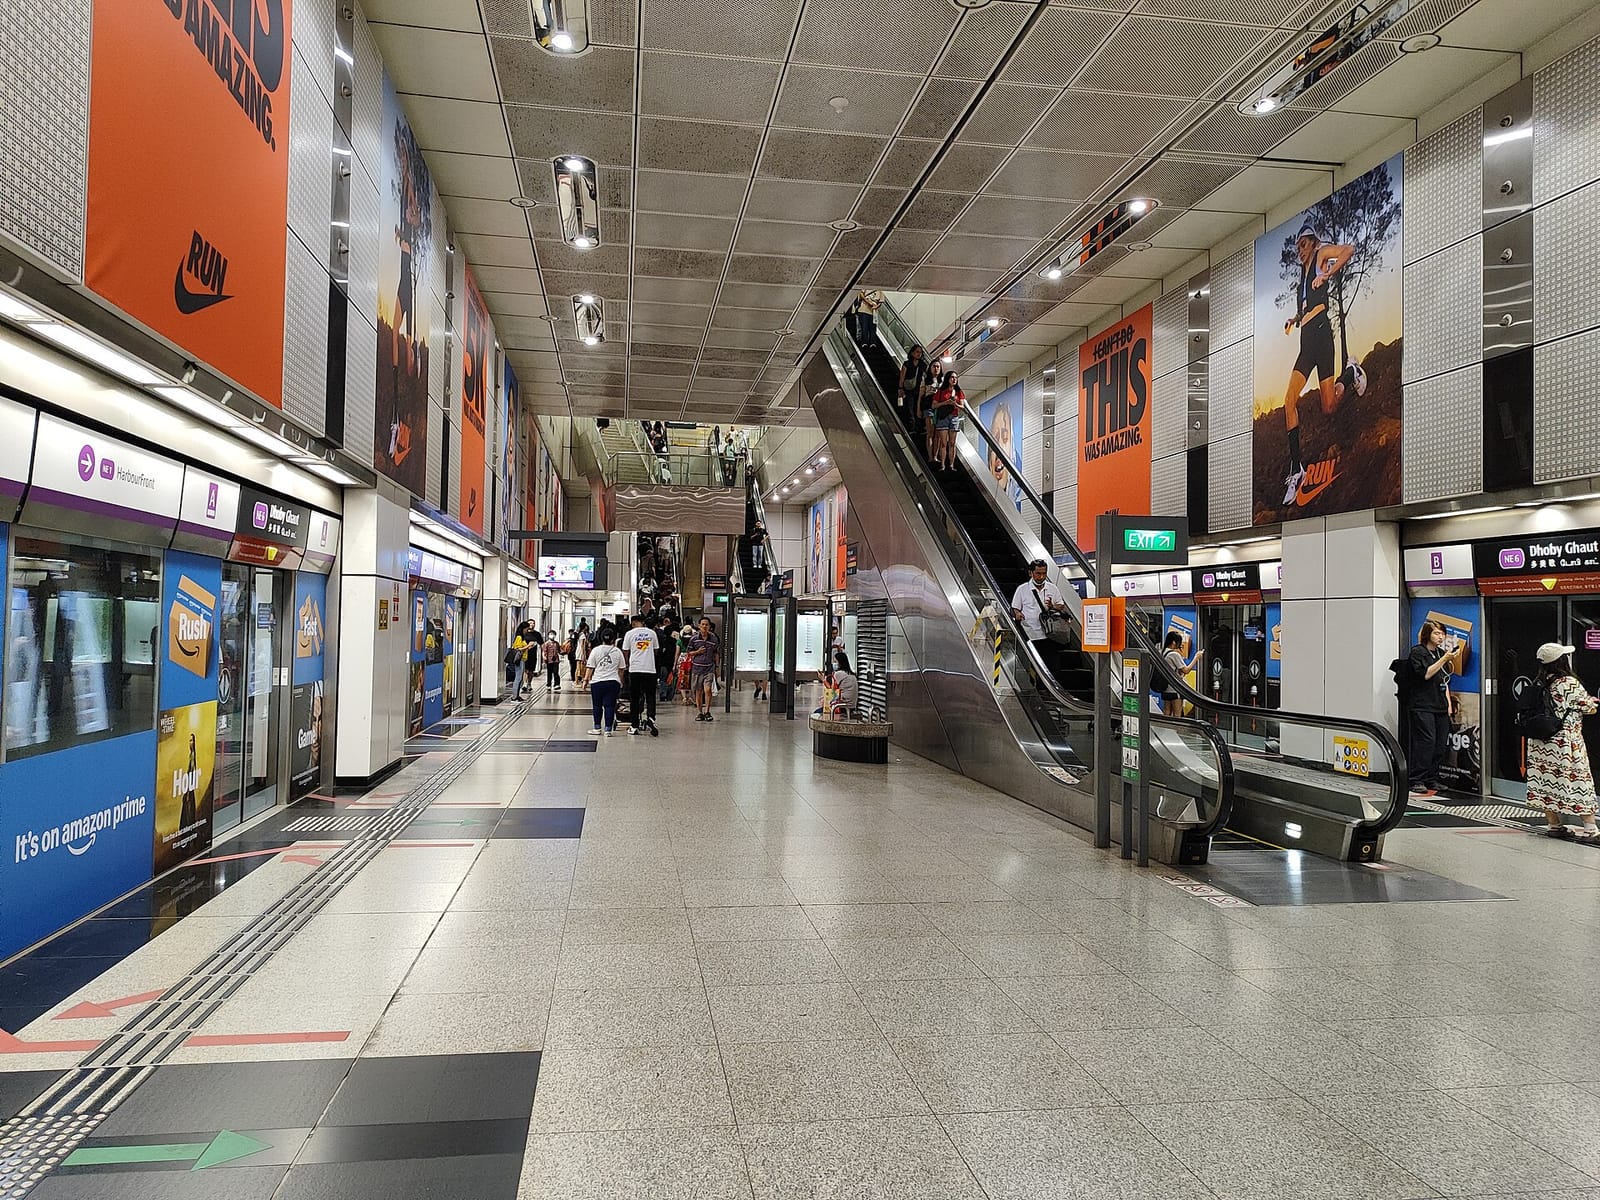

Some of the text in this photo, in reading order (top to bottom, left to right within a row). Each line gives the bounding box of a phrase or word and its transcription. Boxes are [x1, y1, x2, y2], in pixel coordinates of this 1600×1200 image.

[187, 230, 228, 295] RUN
[1082, 338, 1147, 443] THIS
[1084, 427, 1142, 462] WAS AMAZING.
[117, 466, 155, 490] HarbourFront
[1304, 459, 1336, 487] RUN
[208, 489, 216, 507] A
[1128, 532, 1156, 549] EXIT
[1529, 543, 1563, 558] Dhoby
[1565, 540, 1599, 554] Ghaut
[1433, 556, 1440, 568] B
[178, 613, 206, 641] Rush
[303, 616, 317, 636] Fast
[173, 768, 201, 798] Hour
[15, 795, 146, 863] It's on amazon prime
